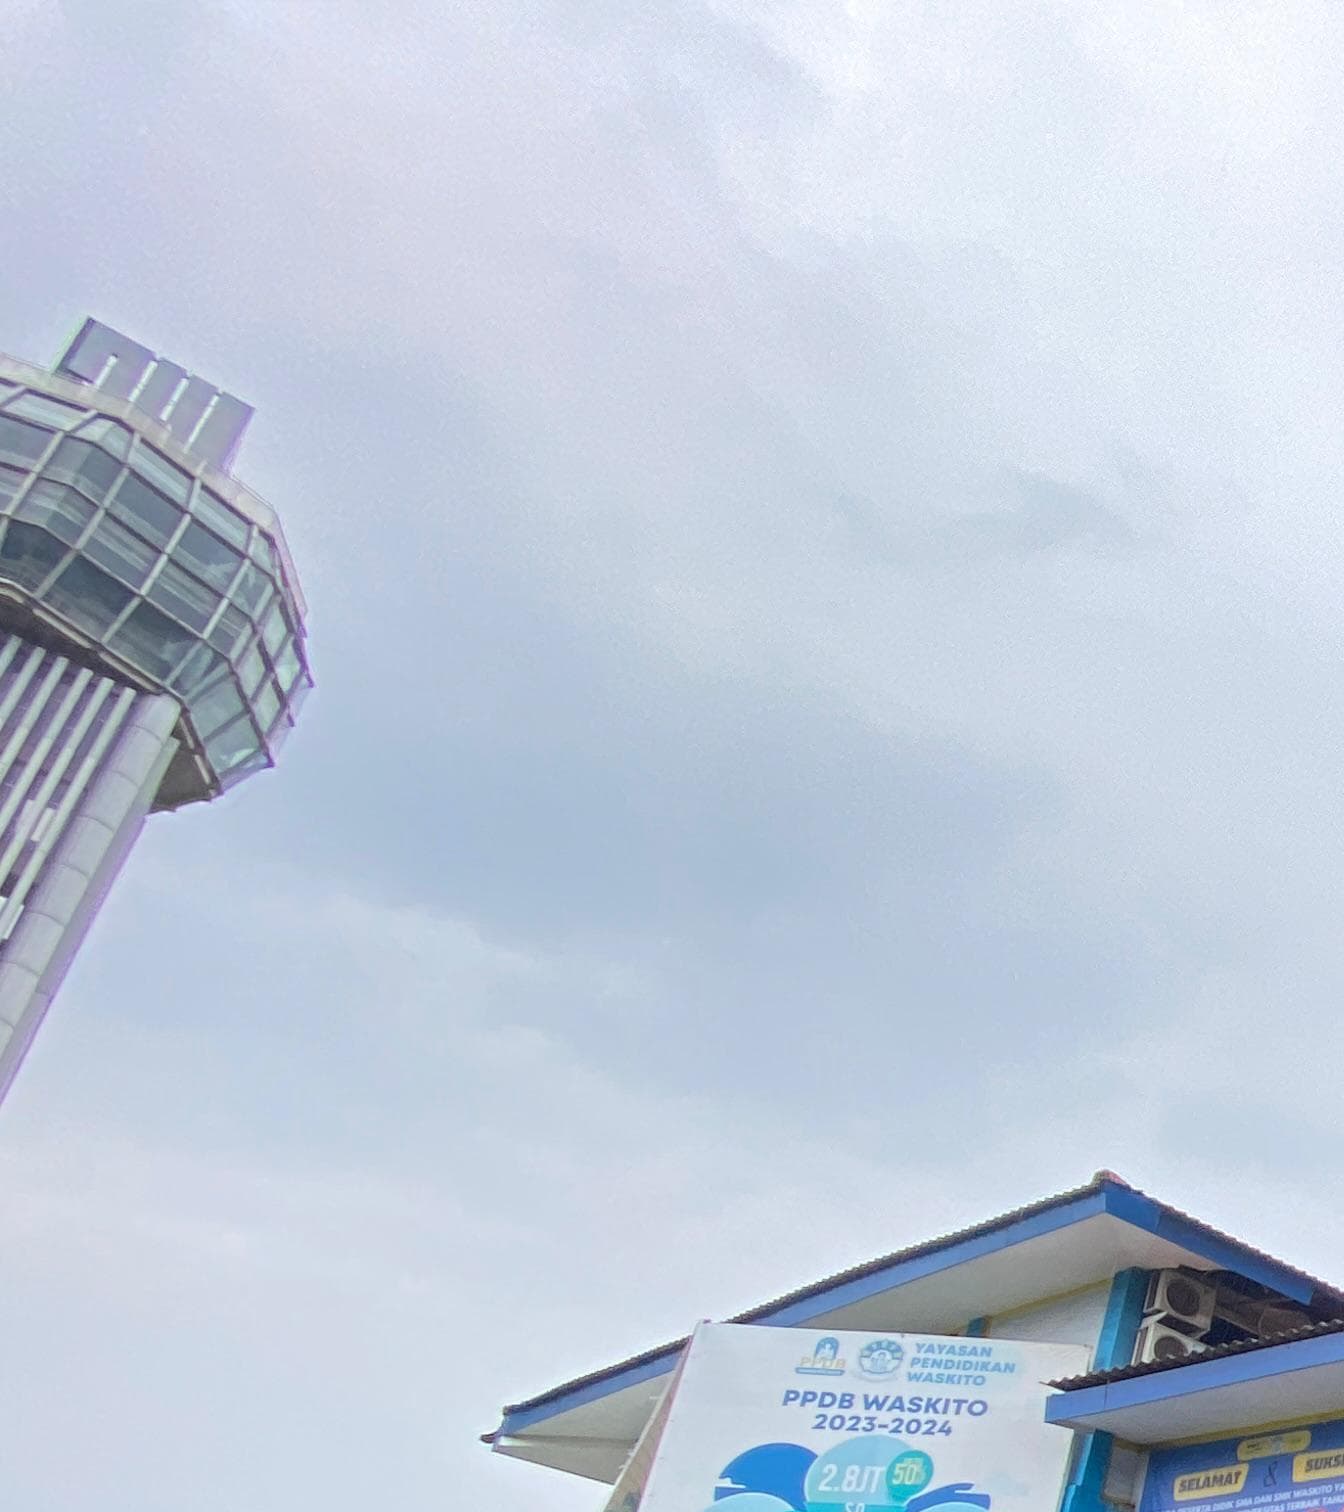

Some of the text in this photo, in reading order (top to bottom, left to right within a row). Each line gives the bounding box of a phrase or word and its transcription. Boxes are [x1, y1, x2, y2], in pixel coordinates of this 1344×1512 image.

[915, 1343, 992, 1357] YAYASAN
[910, 1357, 1016, 1374] PENDIDIKAN
[907, 1371, 986, 1387] WASKITO
[782, 1389, 989, 1417] PPDB WASKITO
[811, 1413, 953, 1437] 2023-2024
[818, 1463, 887, 1493] 2.8JT
[1177, 1469, 1242, 1493] SELAMAT
